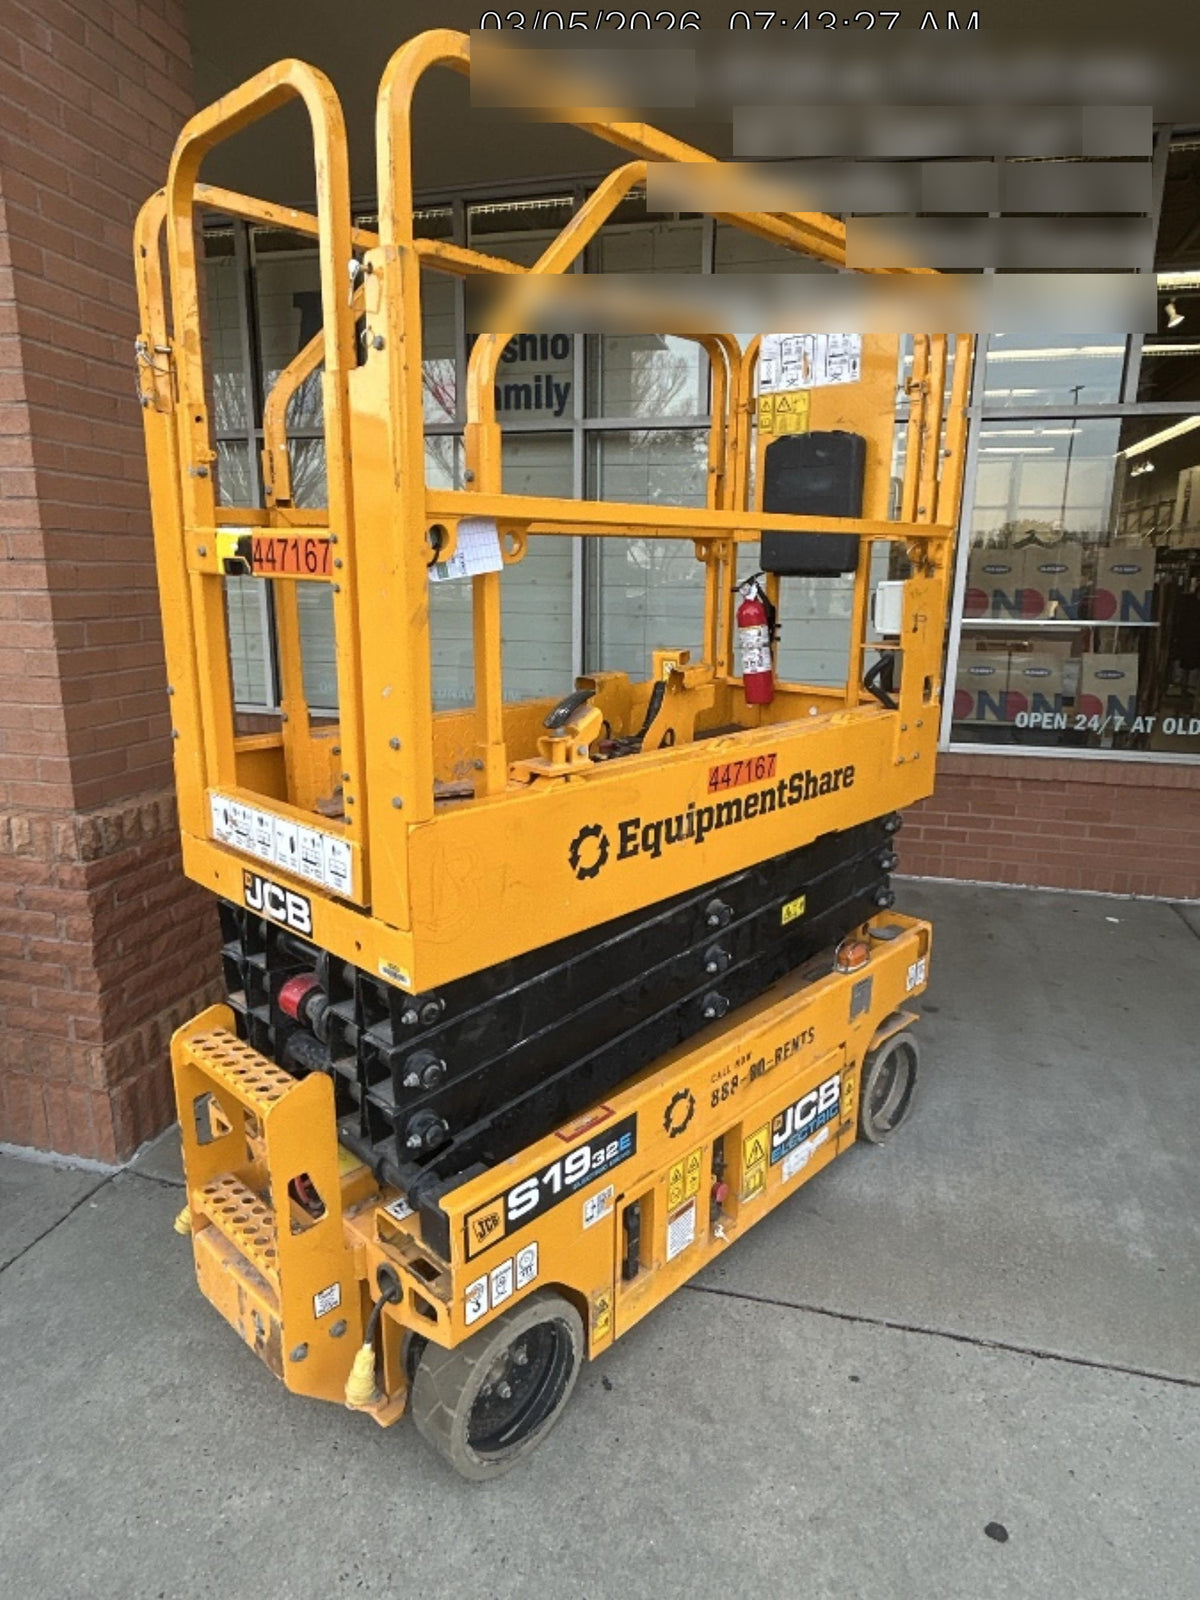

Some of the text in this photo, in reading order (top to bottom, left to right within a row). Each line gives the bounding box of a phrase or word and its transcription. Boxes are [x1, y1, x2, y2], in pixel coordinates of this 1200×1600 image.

[254, 538, 330, 573] 447167
[1015, 711, 1200, 735] OPEN 24/7 AT OLD
[708, 752, 777, 792] 447167
[616, 764, 854, 860] EquipmentShare
[245, 874, 312, 934] JCB
[771, 1103, 840, 1163] ELECTRIC
[772, 1074, 841, 1148] JCB
